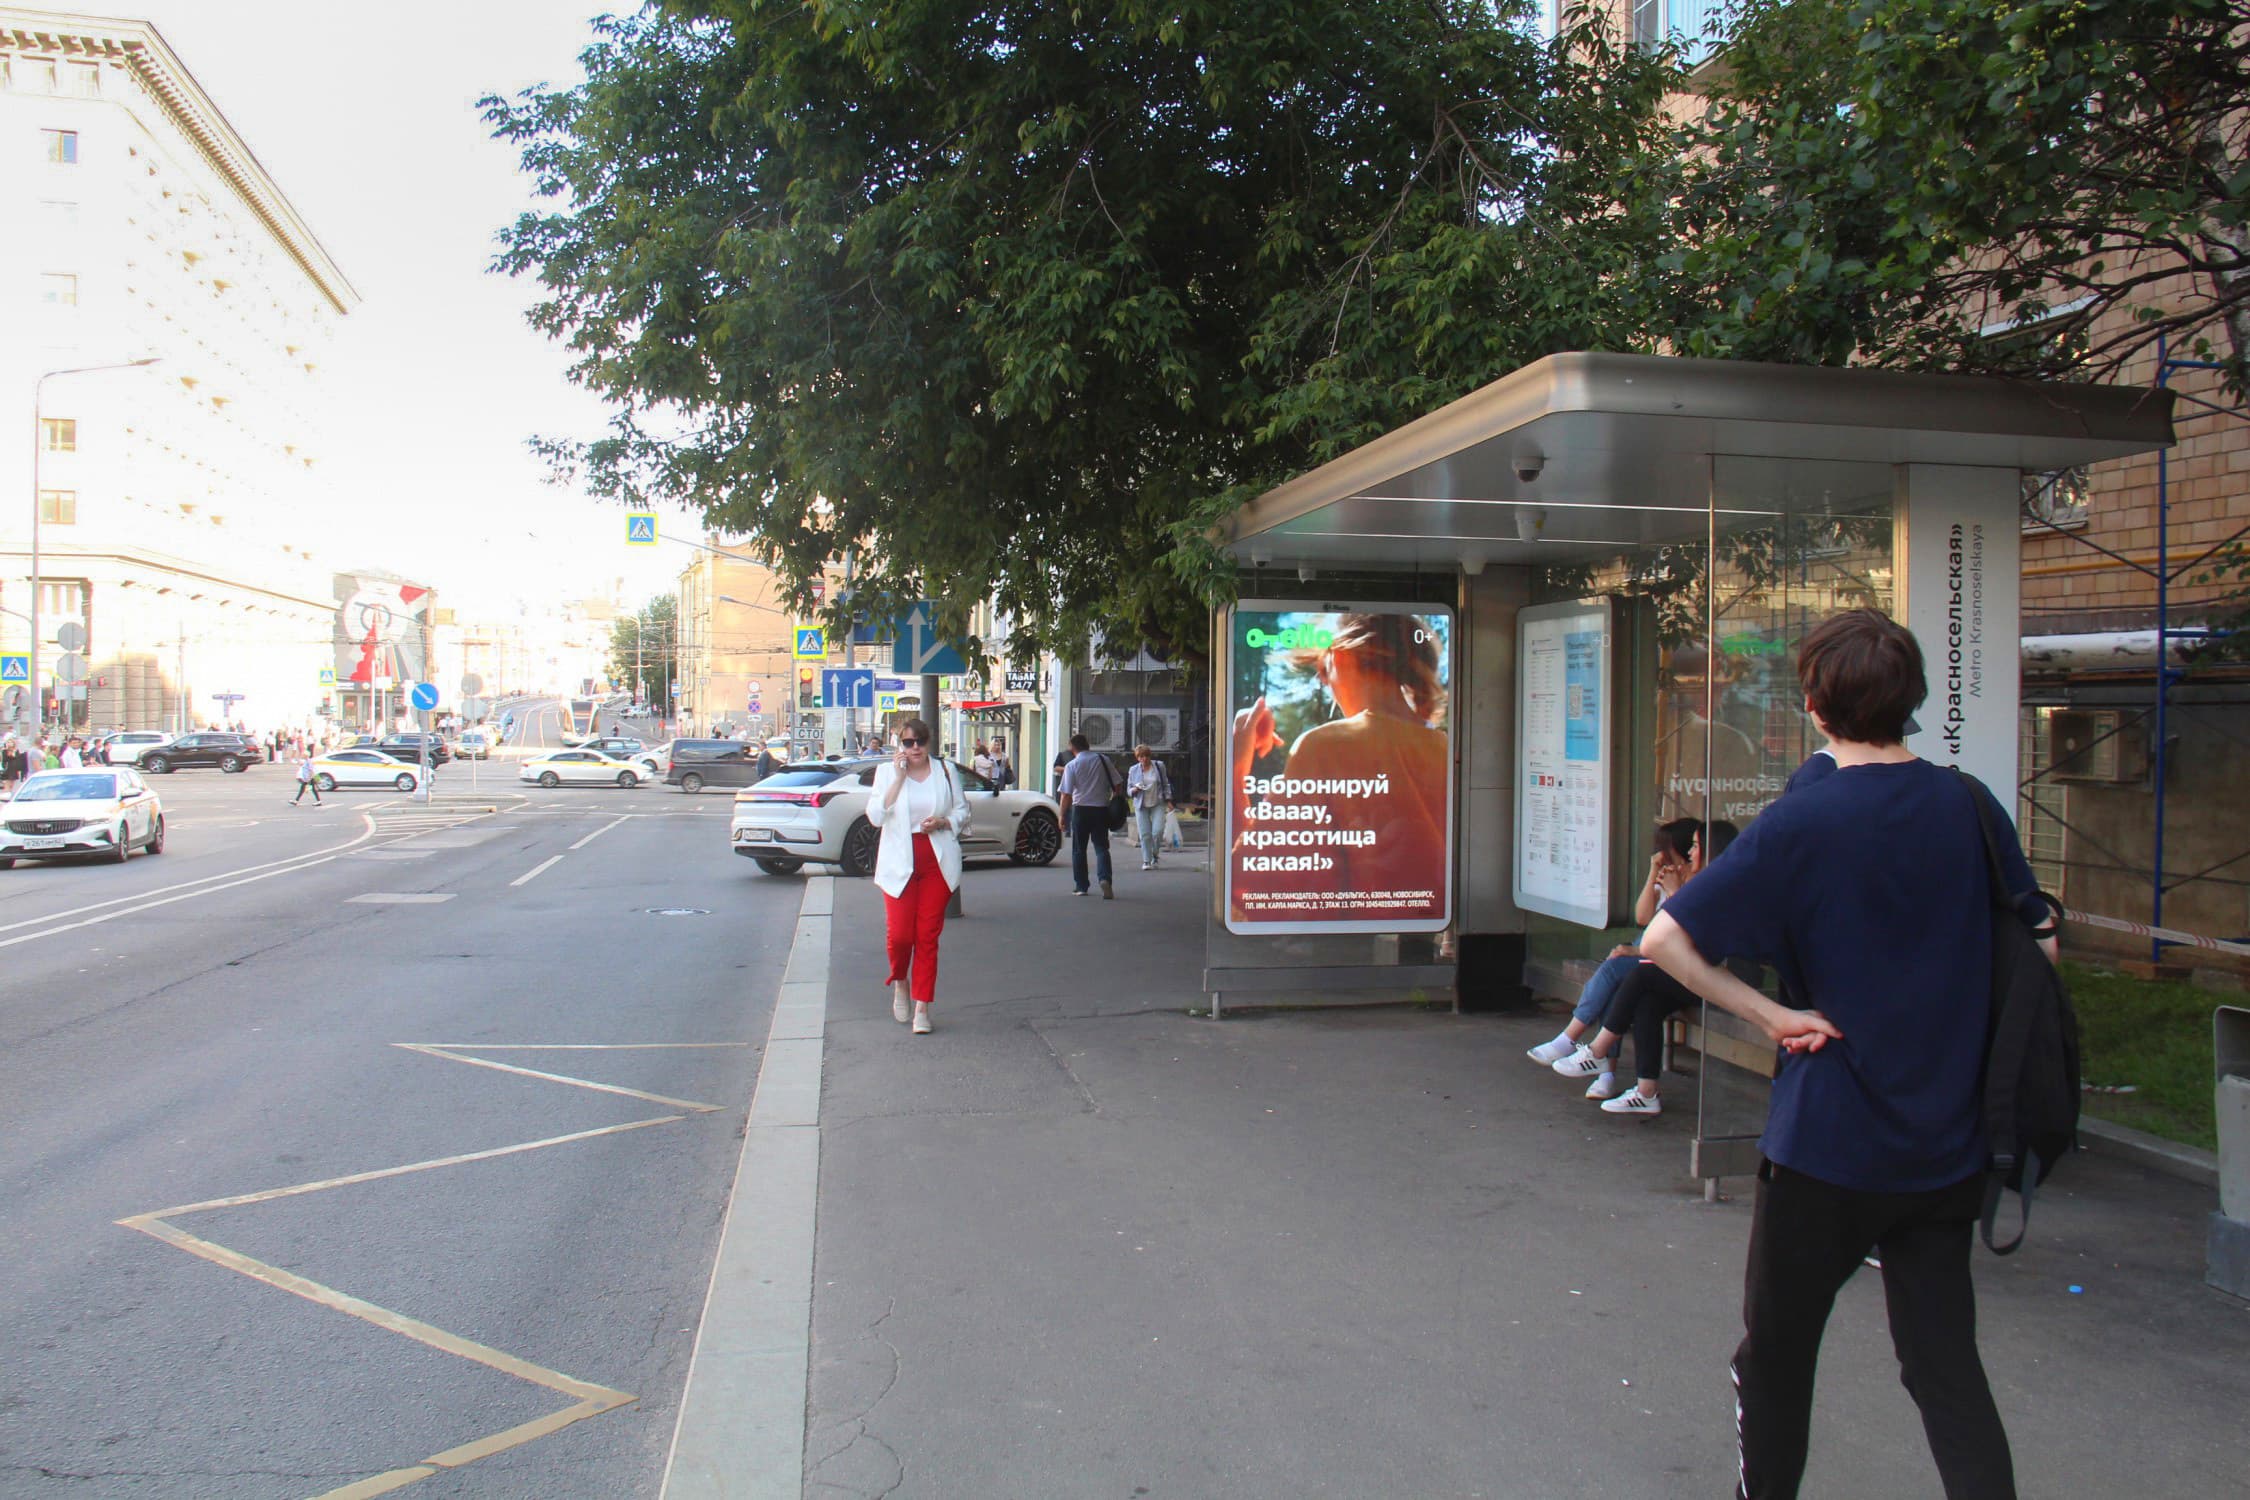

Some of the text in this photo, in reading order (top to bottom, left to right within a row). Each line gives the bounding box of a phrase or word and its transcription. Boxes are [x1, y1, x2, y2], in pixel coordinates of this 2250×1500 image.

[1969, 524, 1984, 698] Metro Krasnoselskaya
[1414, 629, 1433, 644] 0+
[1943, 524, 1965, 754] «Красносельская»
[1243, 774, 1389, 798] Забронируй
[1243, 802, 1332, 824] «Вааау,
[1243, 829, 1377, 850] красотища
[1243, 853, 1333, 872] какая!»
[1242, 892, 1270, 900] РЕКЛАМА.
[1321, 891, 1335, 899] ООО
[1268, 901, 1288, 909] КАРЛА
[1288, 901, 1312, 909] МАРКСА,
